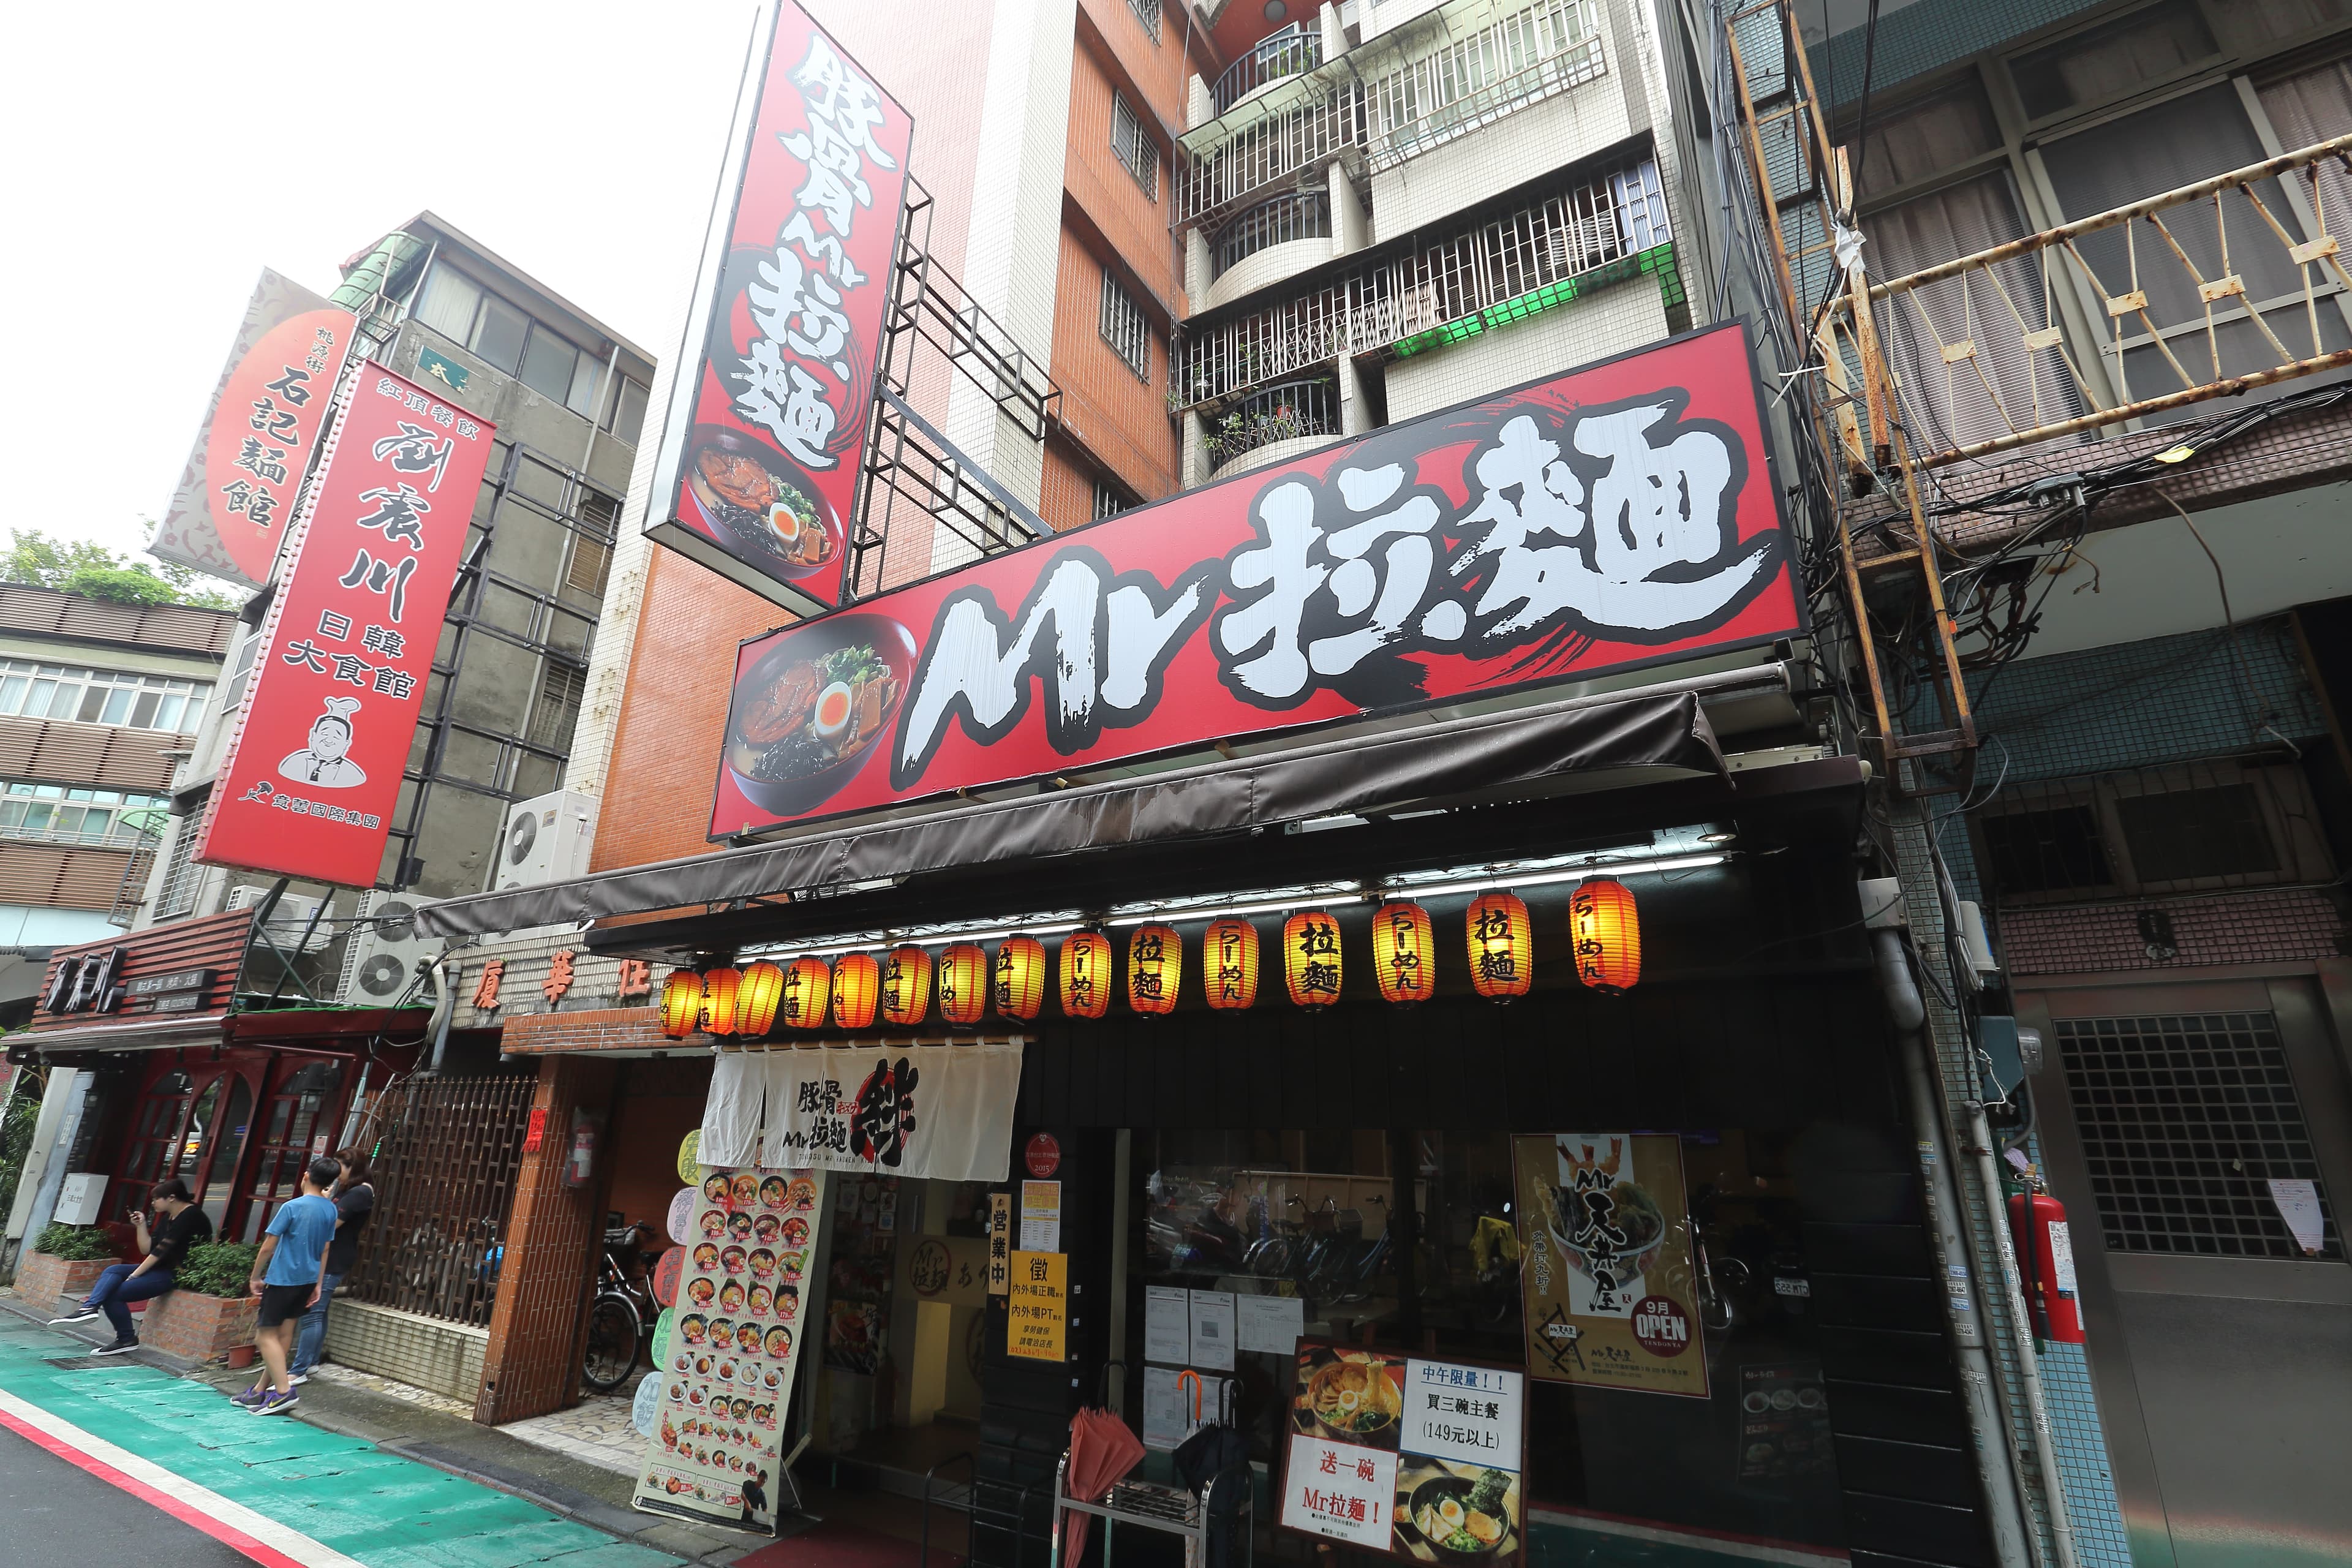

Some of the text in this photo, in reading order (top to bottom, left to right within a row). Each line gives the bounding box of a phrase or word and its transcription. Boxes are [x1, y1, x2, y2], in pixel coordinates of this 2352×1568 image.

[305, 326, 334, 373] 桃源街
[376, 377, 480, 440] 紅頂餐飲
[222, 366, 312, 528] 石記麵館
[317, 609, 406, 659] 日韓
[283, 639, 417, 699] 大食館
[1133, 933, 1166, 1001] 拉麵
[1218, 925, 1245, 1001] らーめん
[1300, 922, 1339, 995] 拉麵
[1390, 911, 1422, 991] らーめん
[1474, 908, 1520, 983] 拉麵
[1068, 938, 1093, 1007] らーめん
[798, 1079, 843, 1115] 豚骨
[1030, 1257, 1048, 1282] 徵
[1635, 1313, 1686, 1341] OPEN
[1646, 1301, 1669, 1315] 9月
[1019, 1337, 1053, 1349] 請電洽店長
[1643, 1340, 1681, 1348] TENDONYA
[1427, 1393, 1499, 1420] 買三碗主餐
[1423, 1421, 1499, 1450] (149元以上)
[1320, 1450, 1376, 1482] 送一碗
